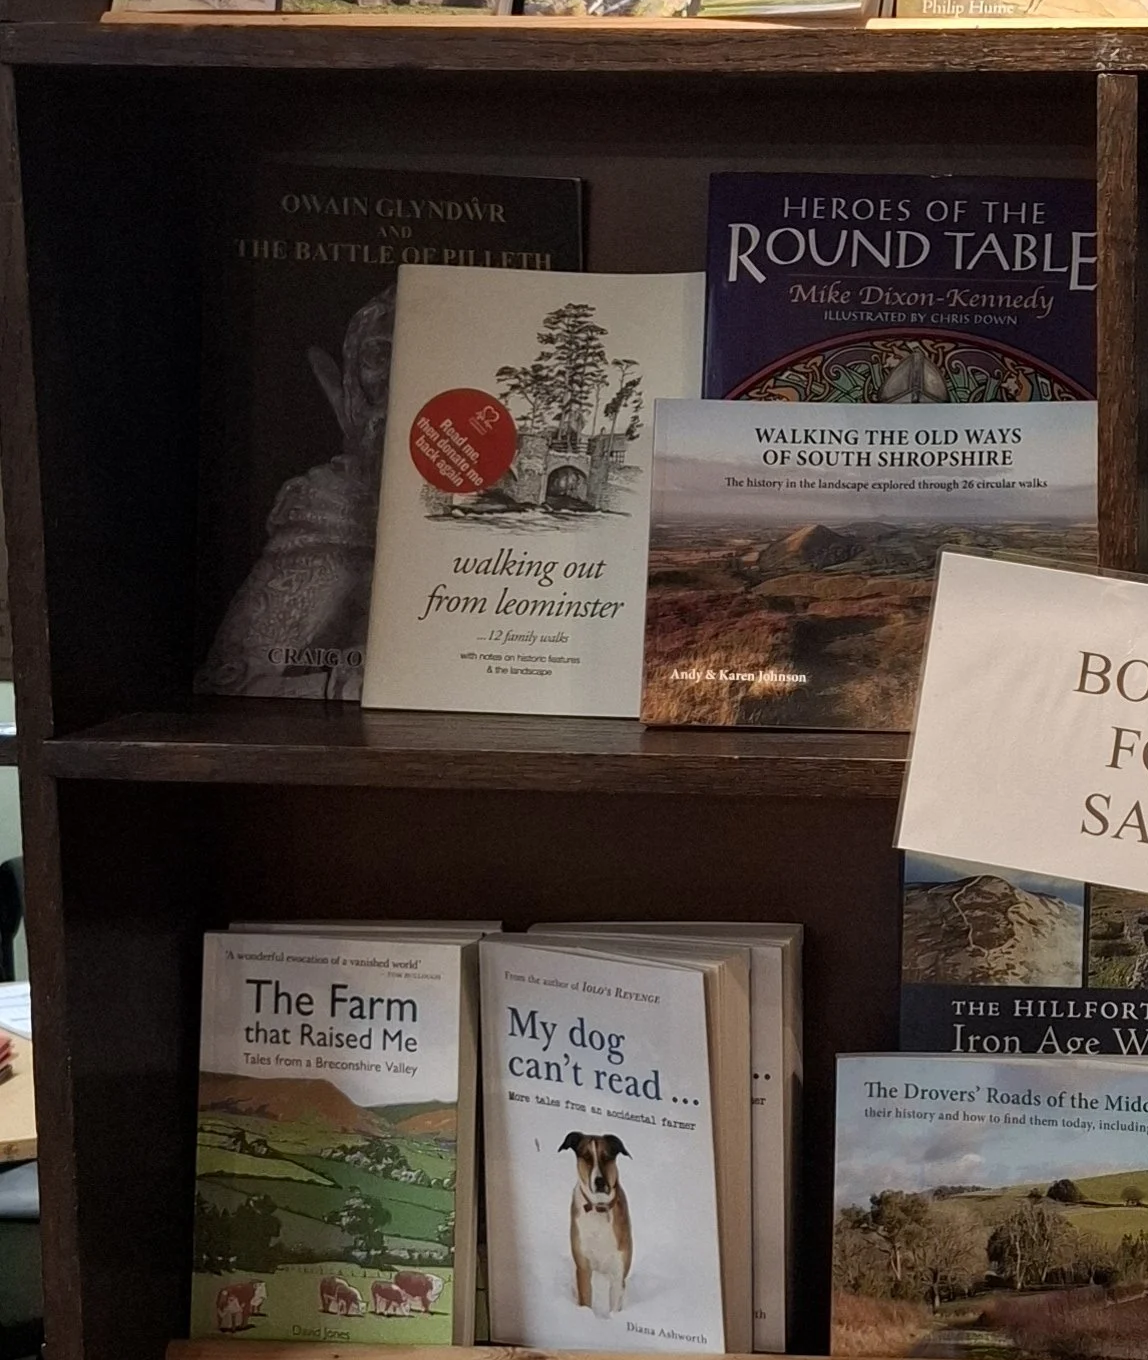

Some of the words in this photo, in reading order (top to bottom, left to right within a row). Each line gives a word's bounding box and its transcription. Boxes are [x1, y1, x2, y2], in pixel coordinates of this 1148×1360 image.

[281, 192, 369, 217] OWAIN
[782, 196, 912, 223] HEROES
[925, 199, 969, 224] OF
[982, 201, 1046, 225] THE
[727, 223, 931, 284] ROUND
[944, 231, 1098, 291] TABLE
[754, 427, 860, 446] WALKING
[864, 429, 910, 446] THE
[914, 428, 959, 446] OLD
[963, 427, 1023, 446] WAYS
[452, 547, 558, 586] walking
[563, 556, 607, 581] out
[417, 584, 488, 622] from
[494, 586, 624, 620] leominster
[245, 978, 315, 1020] The
[329, 983, 419, 1023] Farm
[951, 999, 1001, 1017] THE
[244, 1022, 291, 1046] that
[298, 1024, 373, 1051] Raised
[380, 1028, 419, 1053] Me
[507, 1005, 557, 1041] My
[568, 1018, 626, 1066] dog
[593, 1066, 663, 1102] read
[864, 1081, 899, 1099] The
[985, 1087, 1042, 1107] Roads
[1046, 1091, 1067, 1109] of
[1070, 1092, 1099, 1110] the
